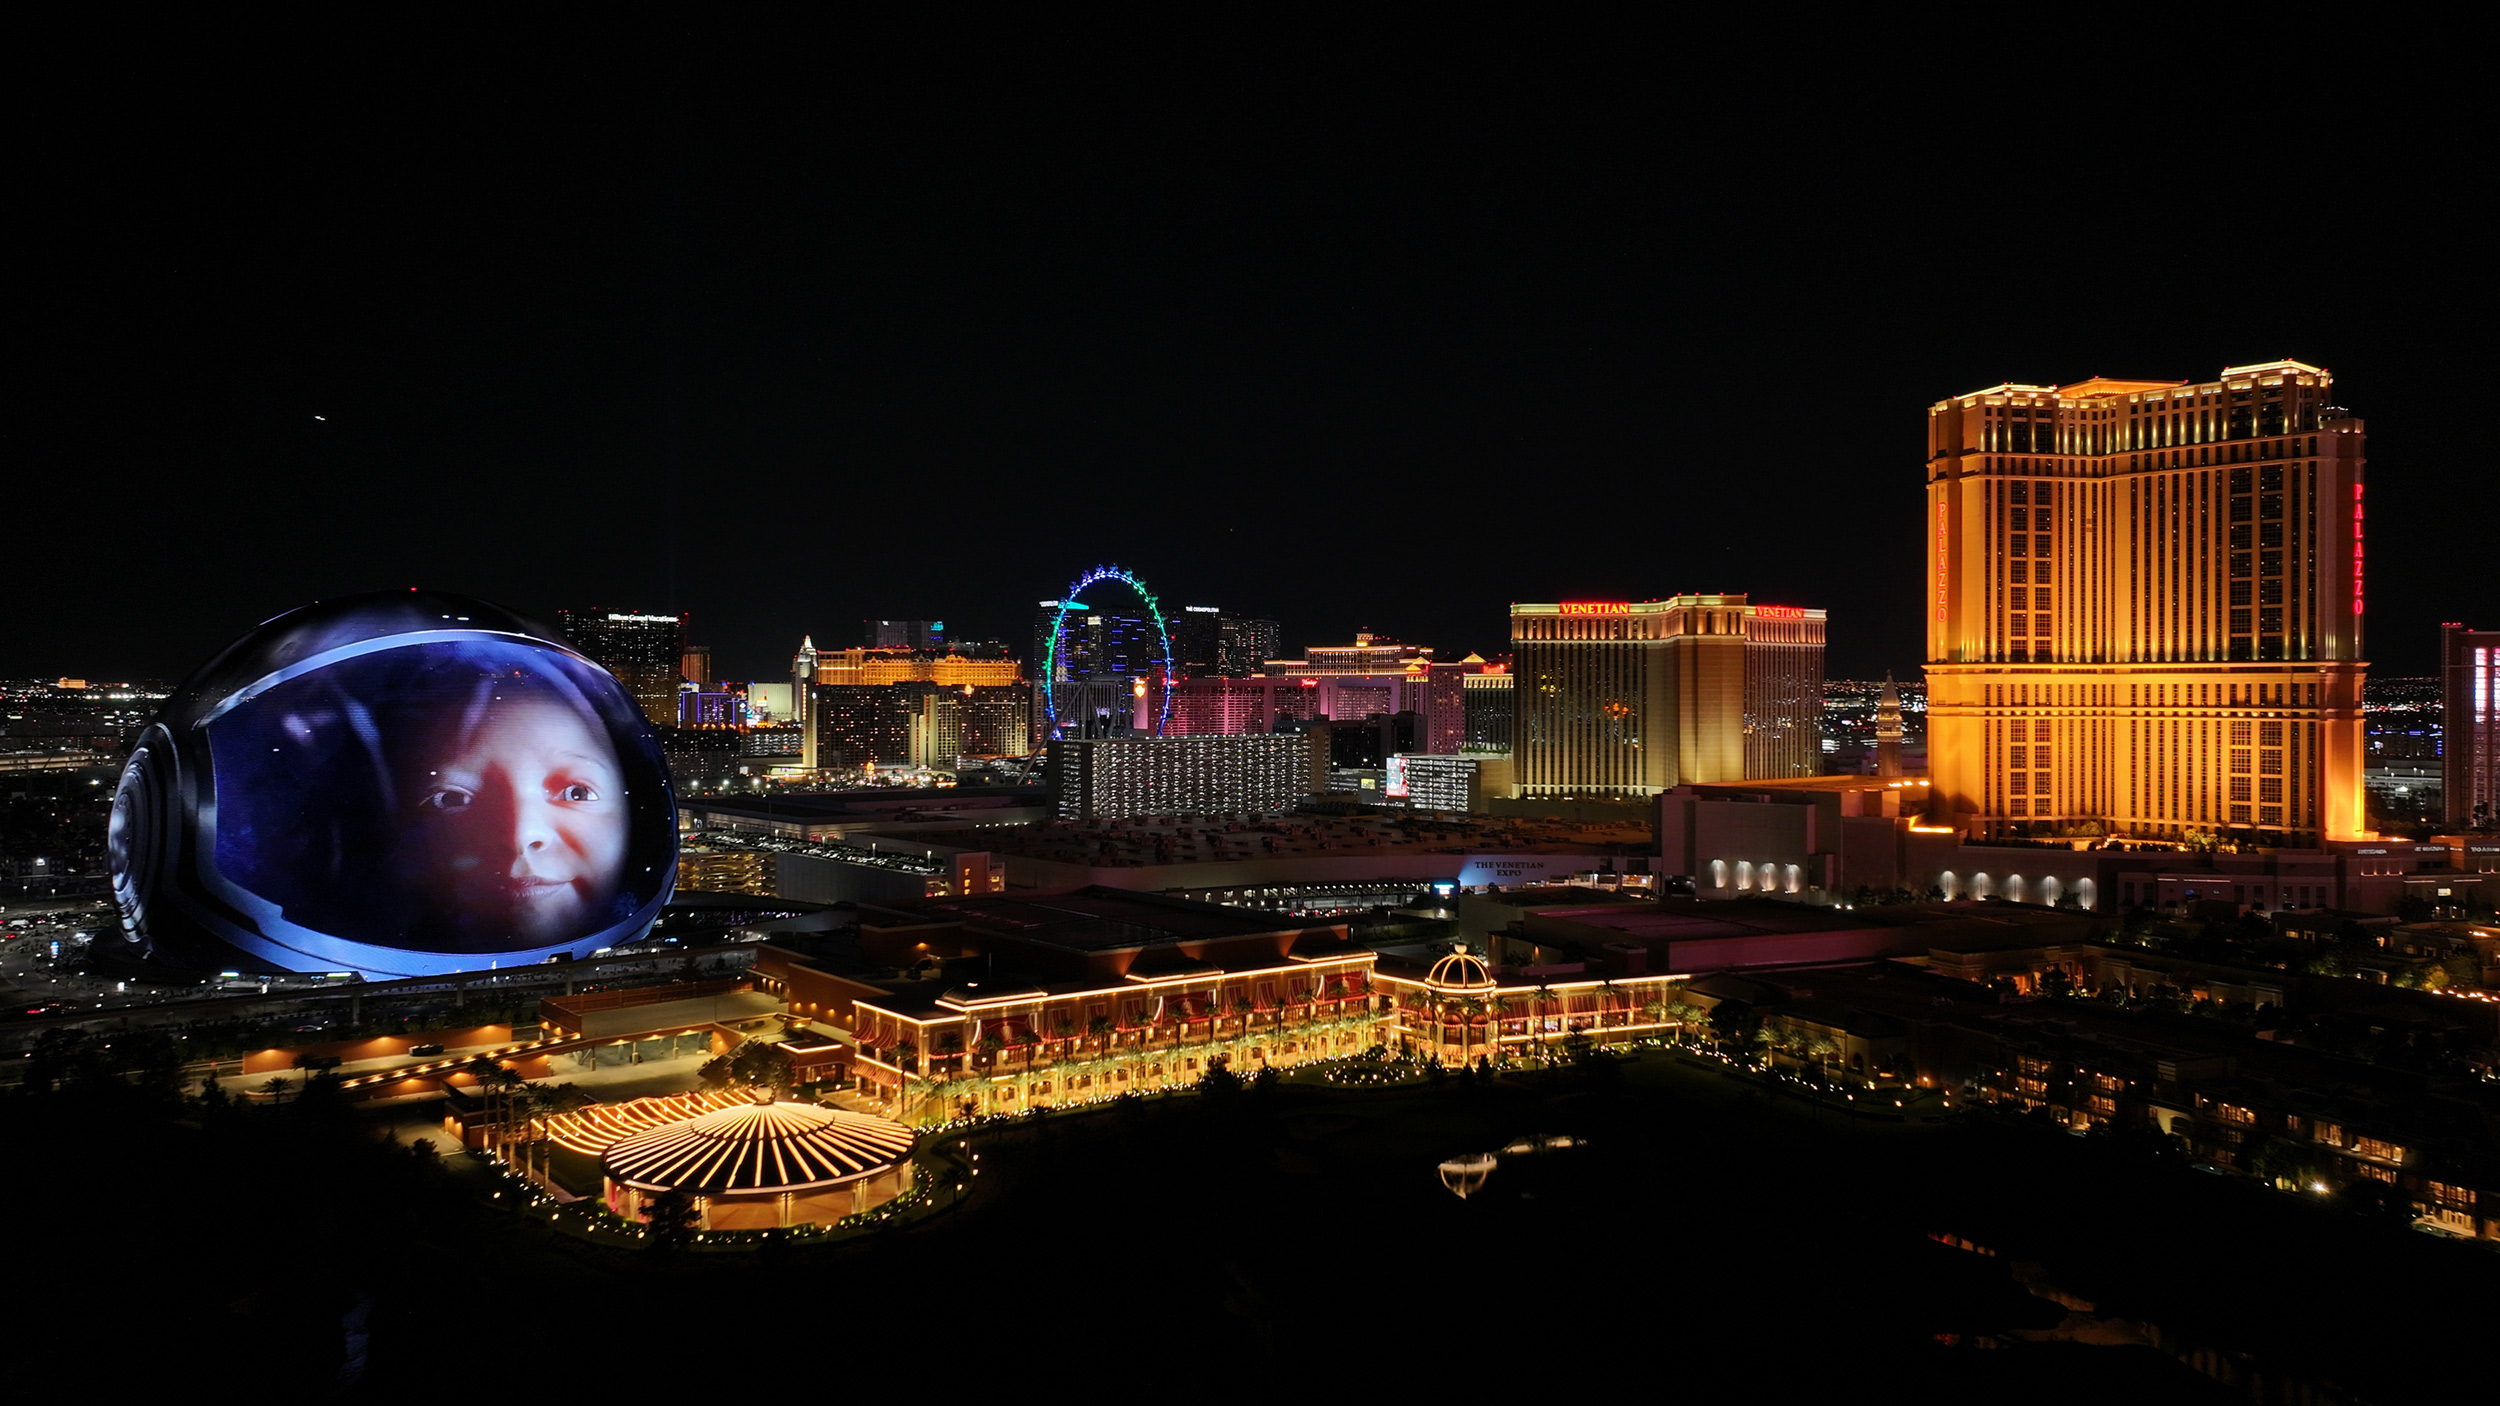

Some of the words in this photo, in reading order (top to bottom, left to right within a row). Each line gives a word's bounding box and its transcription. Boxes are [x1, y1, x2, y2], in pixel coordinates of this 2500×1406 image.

[2353, 484, 2364, 615] PALAZZO
[1937, 503, 1947, 622] PALAZZO
[1561, 603, 1629, 614] VENETIAN
[1757, 607, 1802, 618] VENETIAN
[629, 614, 648, 622] Grand
[1495, 861, 1544, 869] VENETIAN
